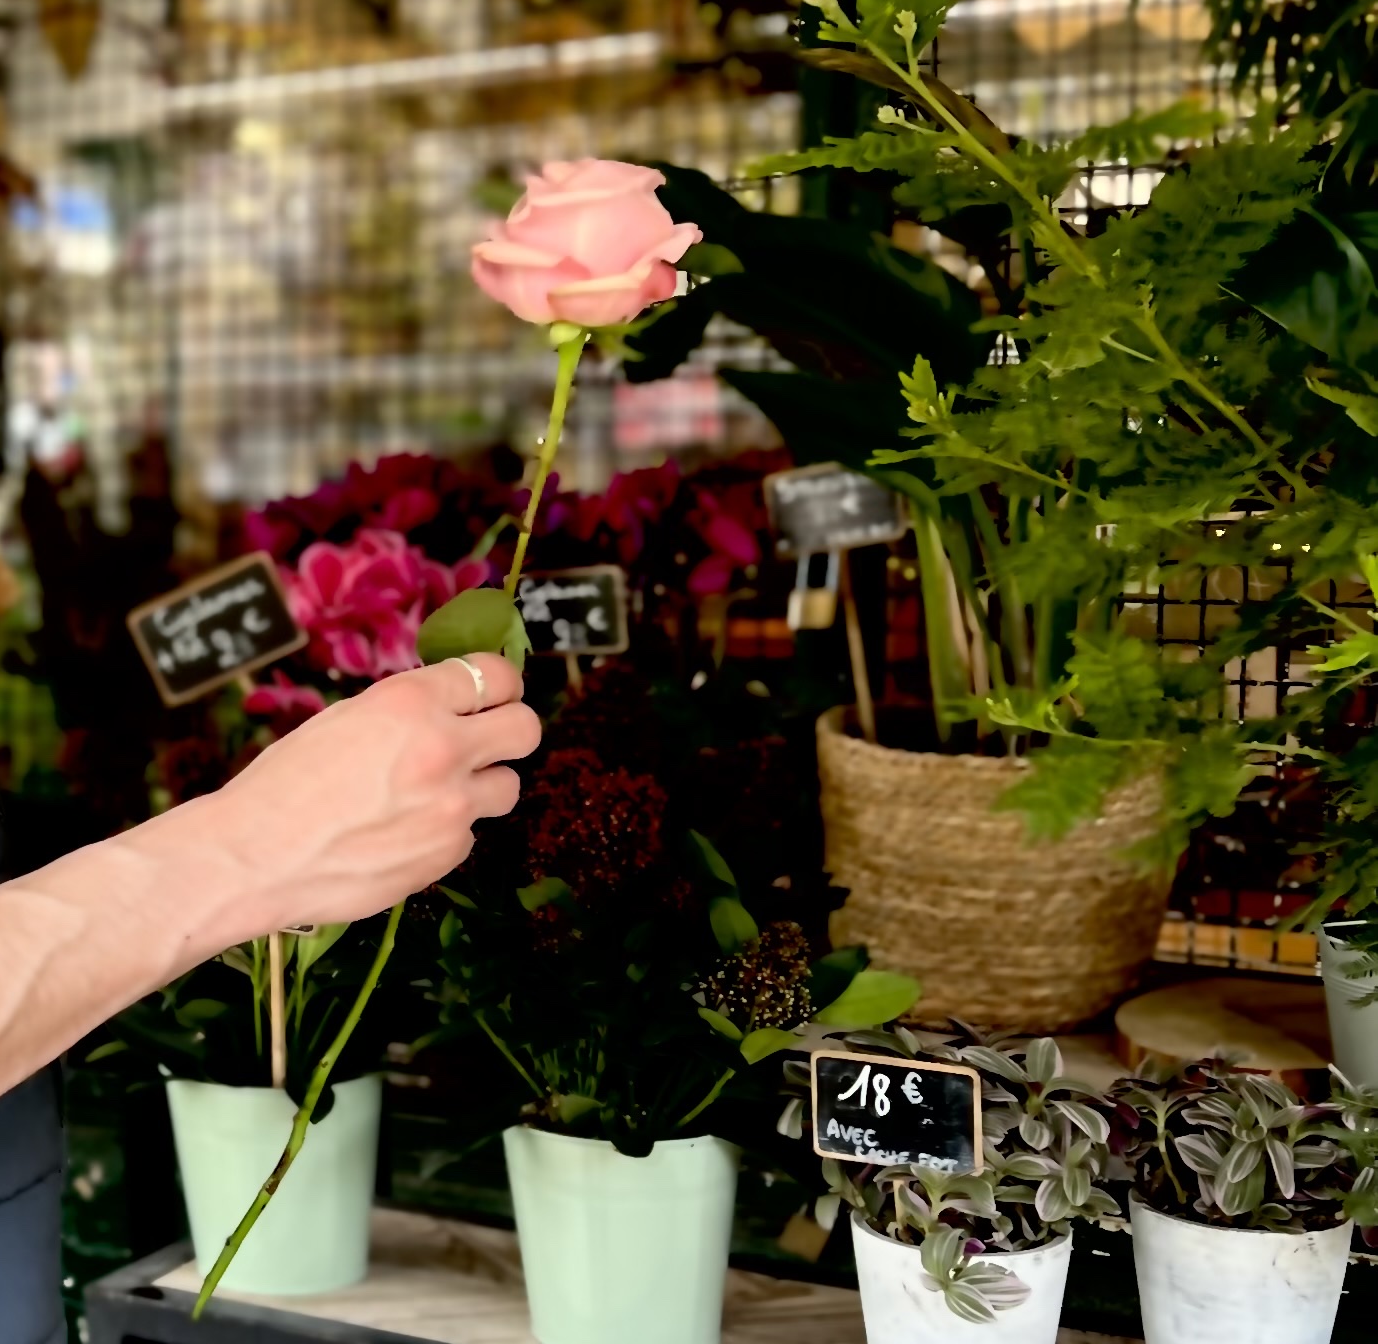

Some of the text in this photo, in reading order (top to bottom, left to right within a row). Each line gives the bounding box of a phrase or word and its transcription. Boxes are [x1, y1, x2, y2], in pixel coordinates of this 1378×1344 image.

[837, 1064, 924, 1117] 18 €
[826, 1117, 880, 1148] AVEC
